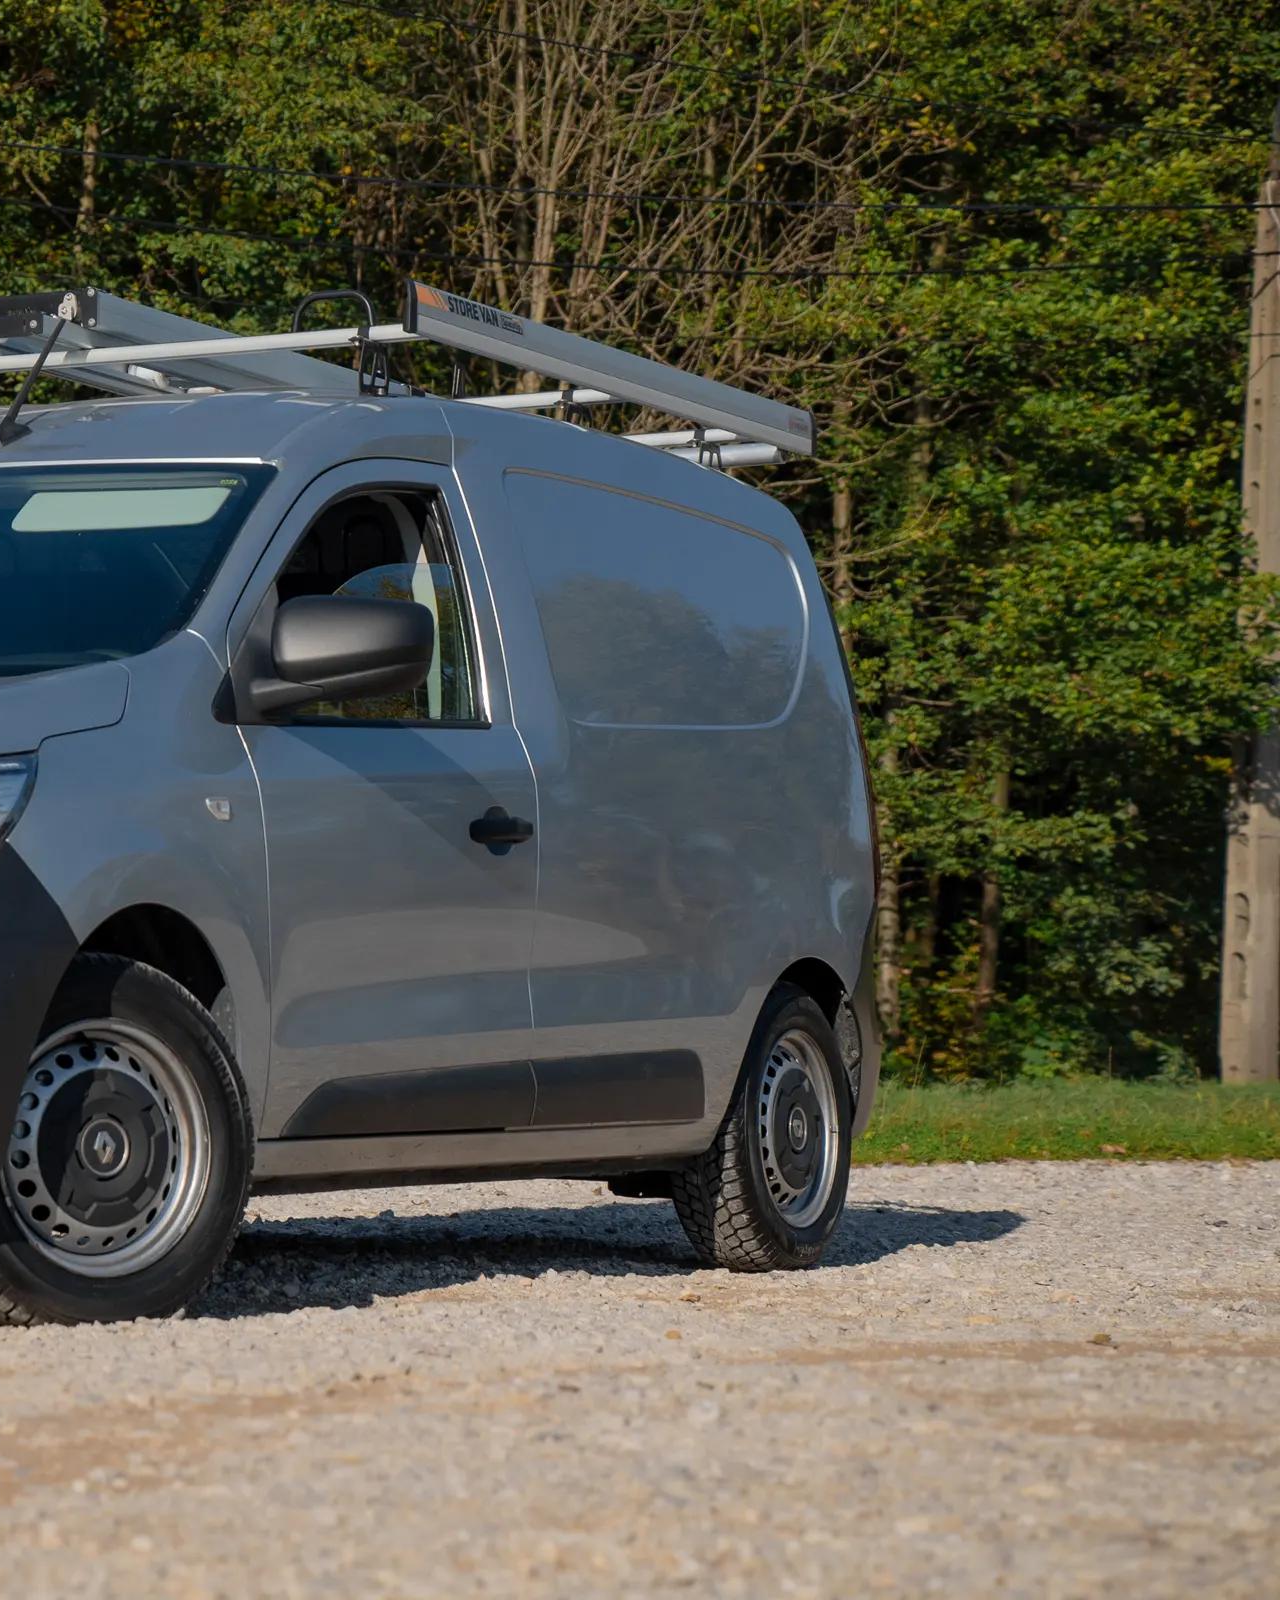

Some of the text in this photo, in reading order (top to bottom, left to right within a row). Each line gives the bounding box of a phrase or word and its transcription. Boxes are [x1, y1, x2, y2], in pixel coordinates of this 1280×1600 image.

[448, 296, 480, 321] STORE
[479, 306, 500, 328] VAN
[209, 1043, 240, 1116] WINTER
